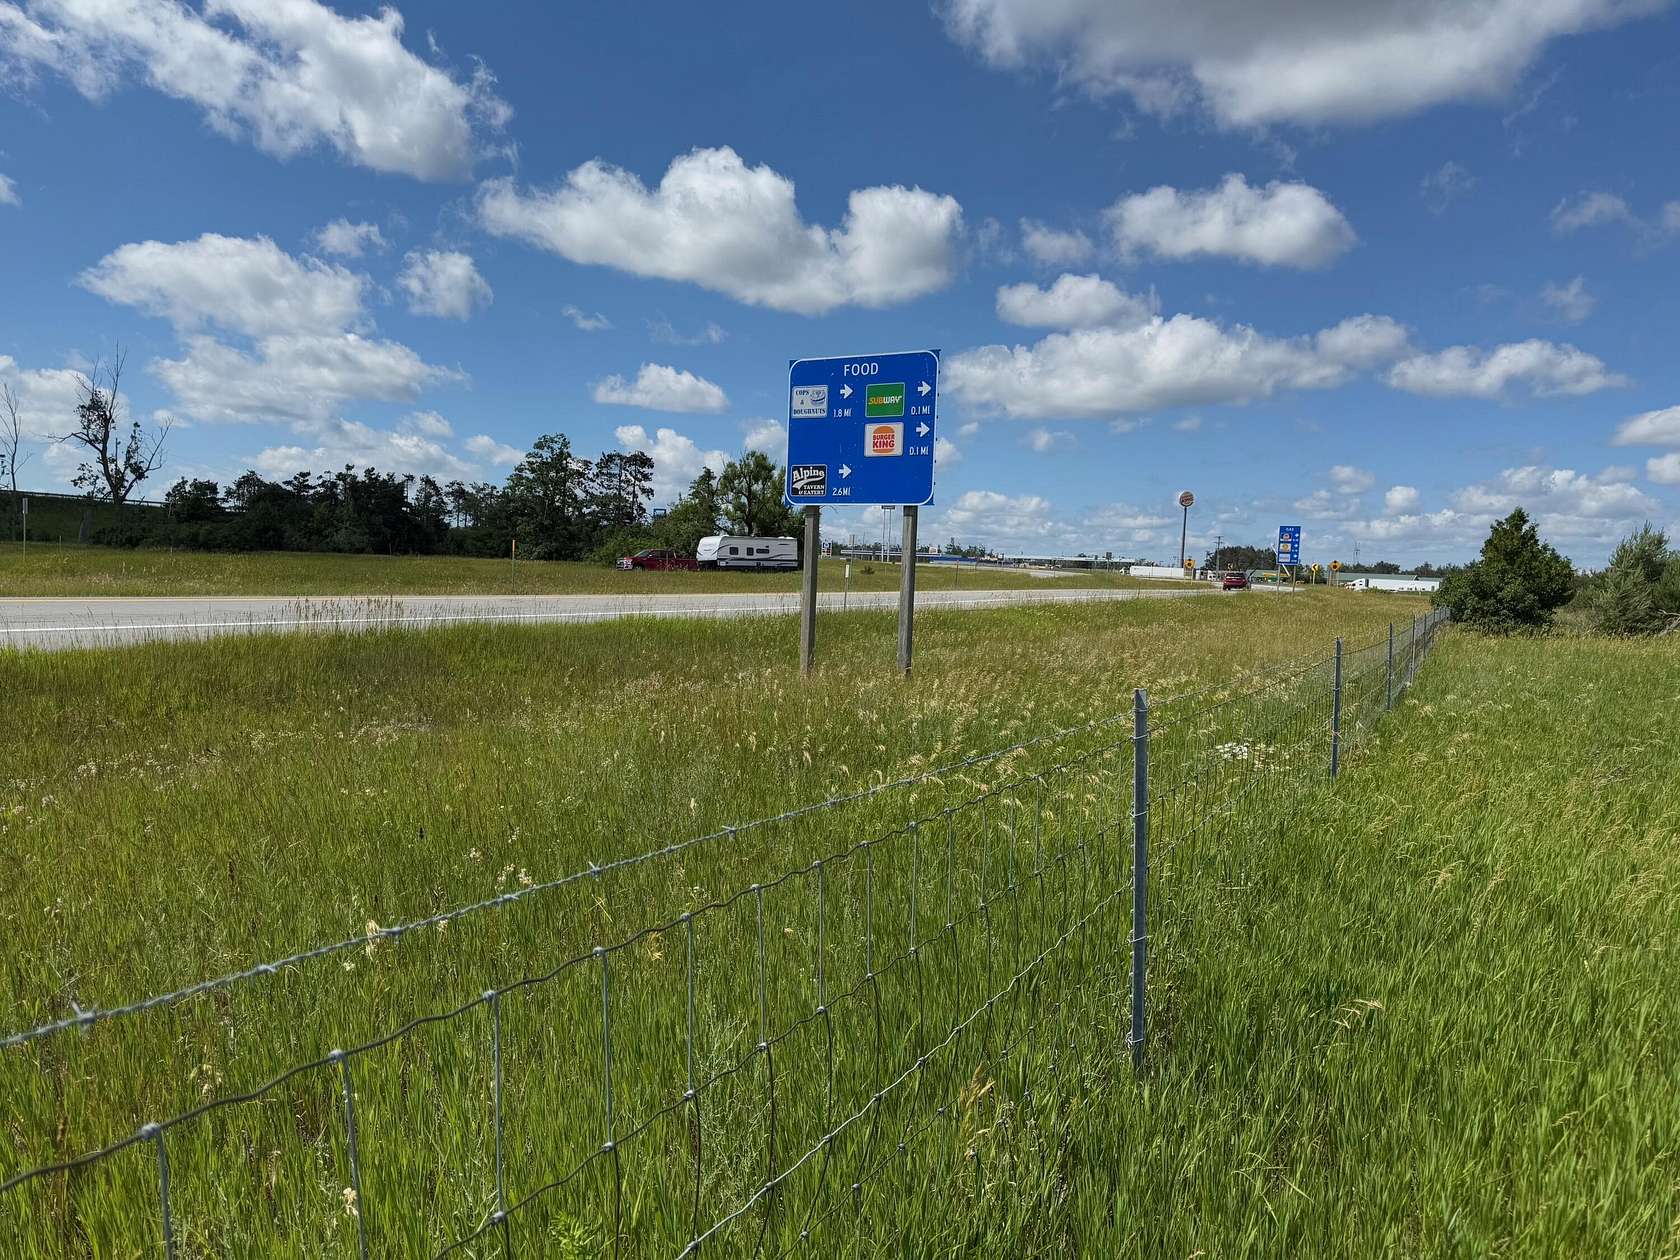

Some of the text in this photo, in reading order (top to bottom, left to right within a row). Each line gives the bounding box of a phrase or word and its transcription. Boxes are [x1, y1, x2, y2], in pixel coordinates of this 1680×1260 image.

[844, 363, 879, 376] FOOD
[868, 395, 903, 405] SUBWAY
[833, 408, 852, 418] 1.8 MI
[910, 405, 930, 415] 0.1 MI
[872, 440, 895, 449] KING
[909, 446, 929, 456] 0.1 MI
[792, 466, 825, 482] Alpine
